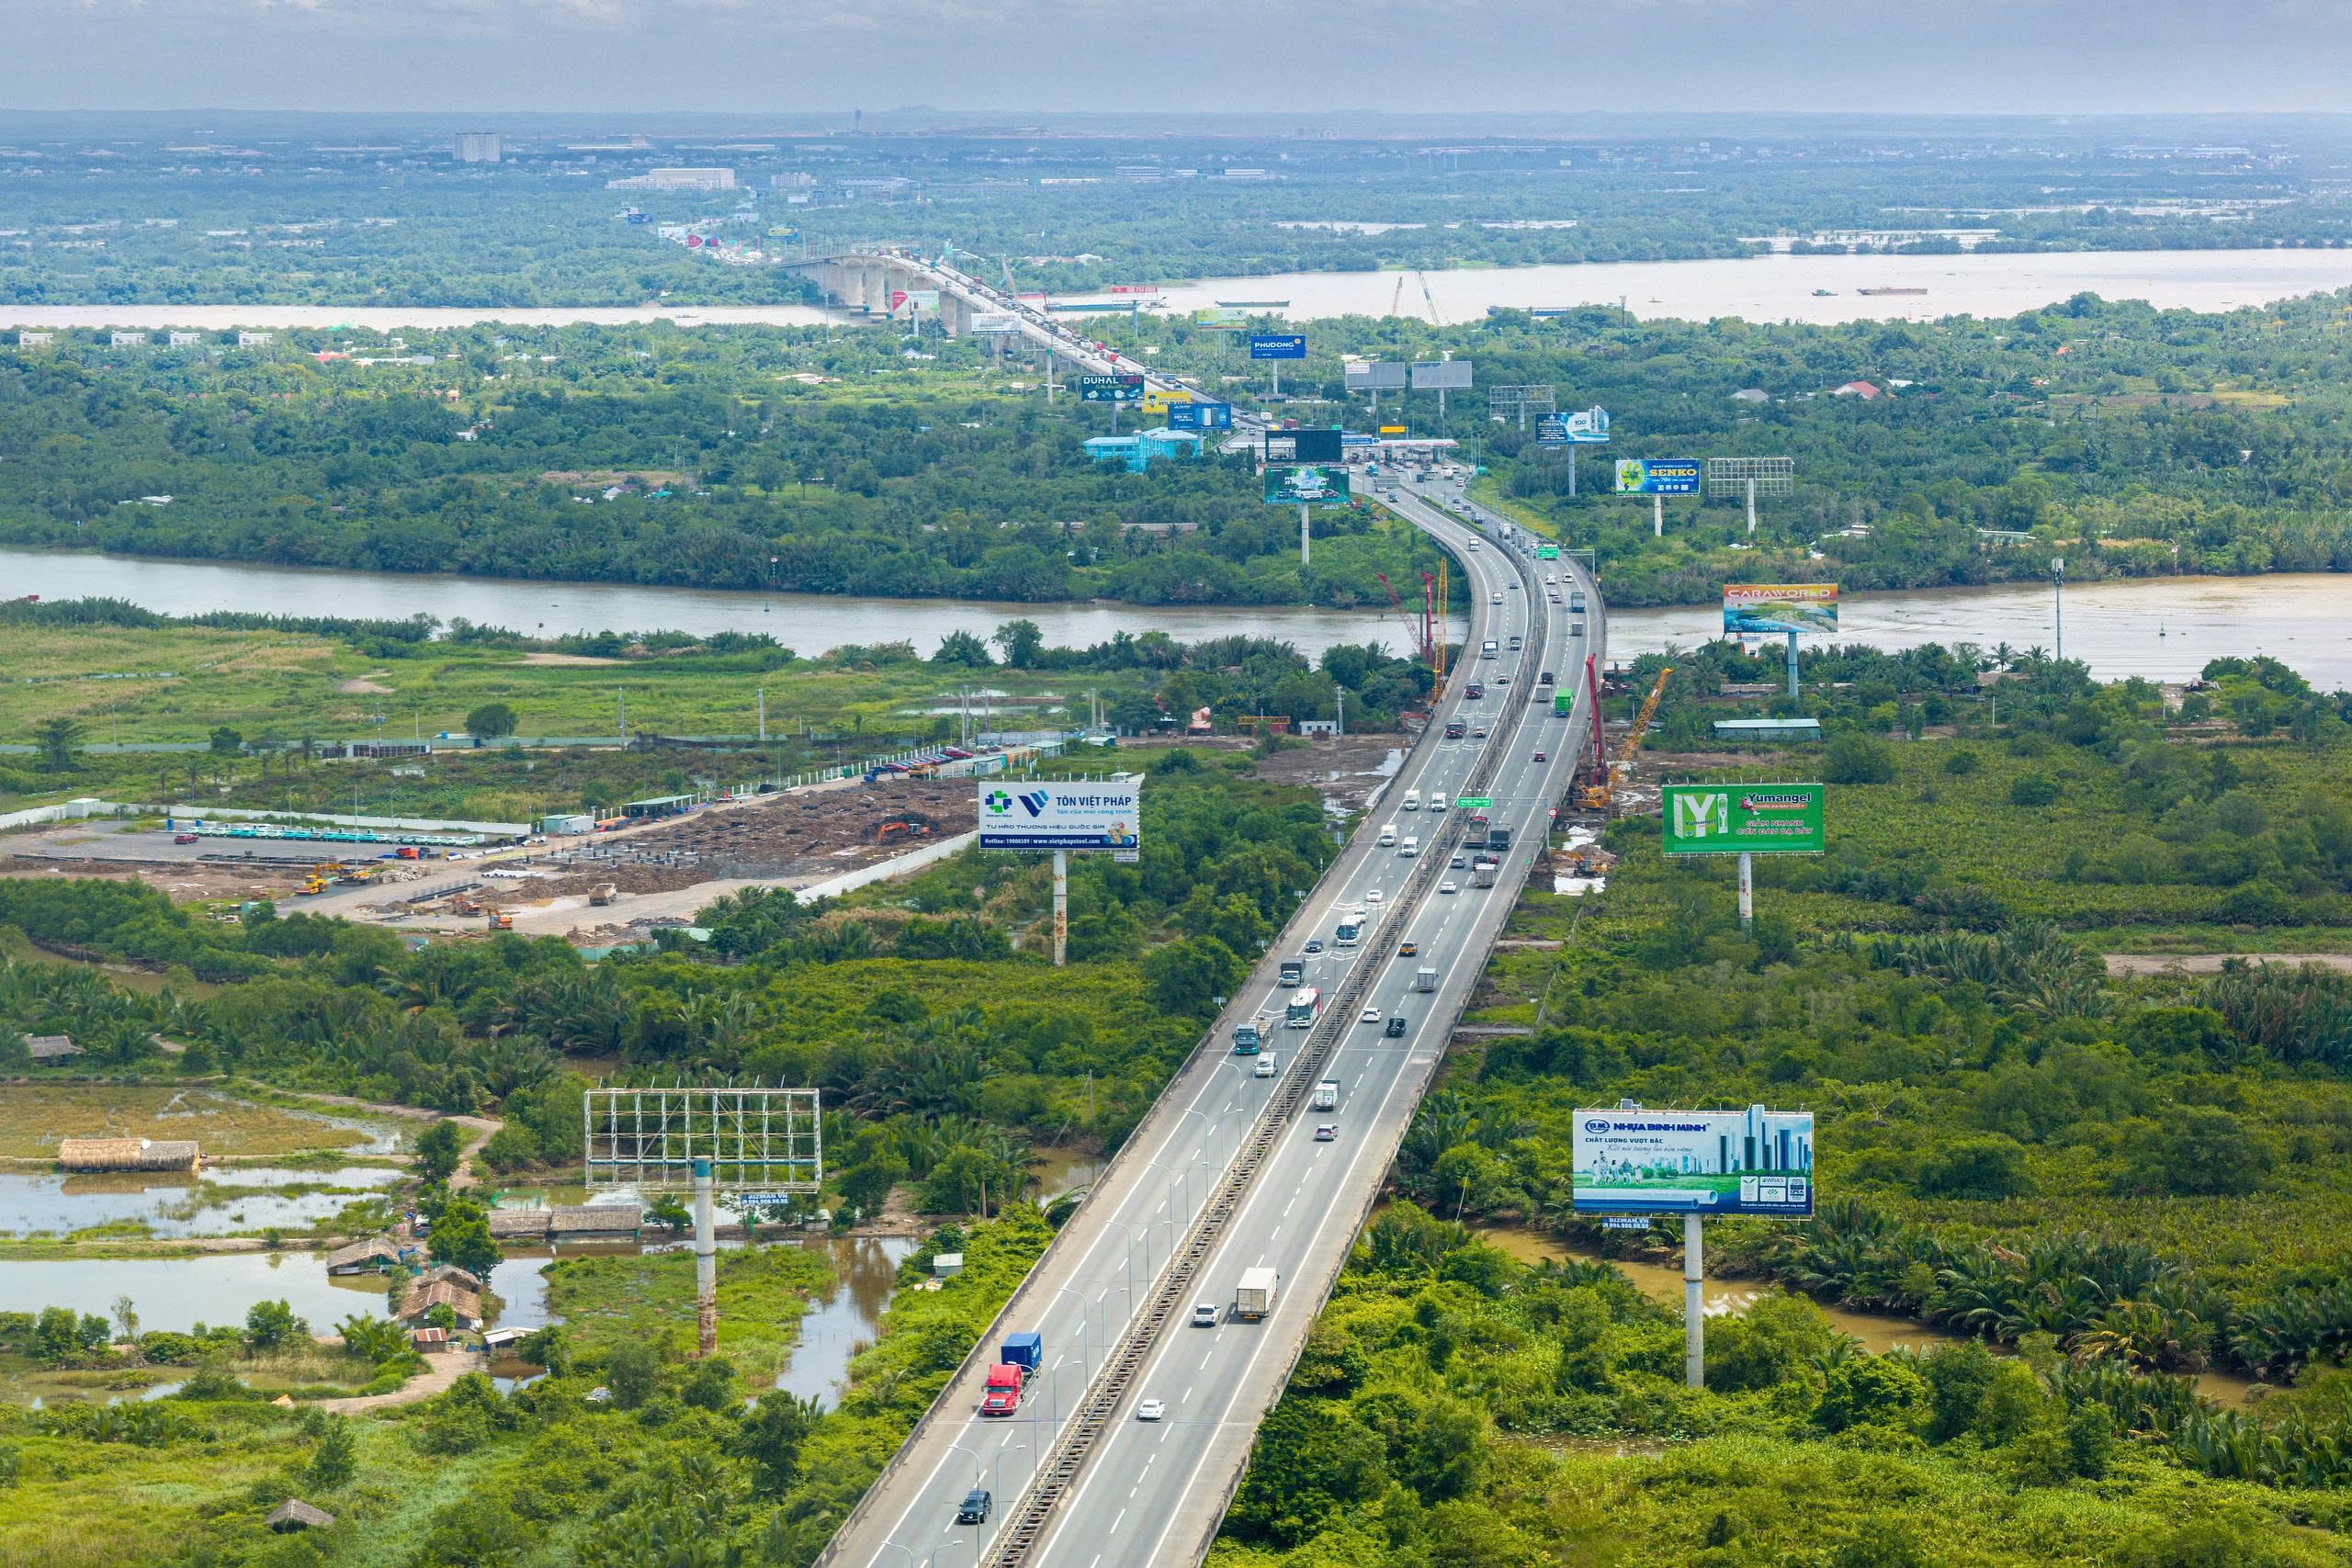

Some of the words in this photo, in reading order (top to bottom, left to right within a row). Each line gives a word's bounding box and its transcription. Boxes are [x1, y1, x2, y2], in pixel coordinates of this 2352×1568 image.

[1649, 468, 1697, 477] SENKO
[1056, 795, 1077, 807] TÔN
[1079, 795, 1101, 808] VIỆT
[1103, 795, 1132, 807] PHÁP
[1747, 793, 1812, 804] Yumangel
[1613, 1122, 1645, 1132] NHỰA
[1677, 1123, 1706, 1132] MINH
